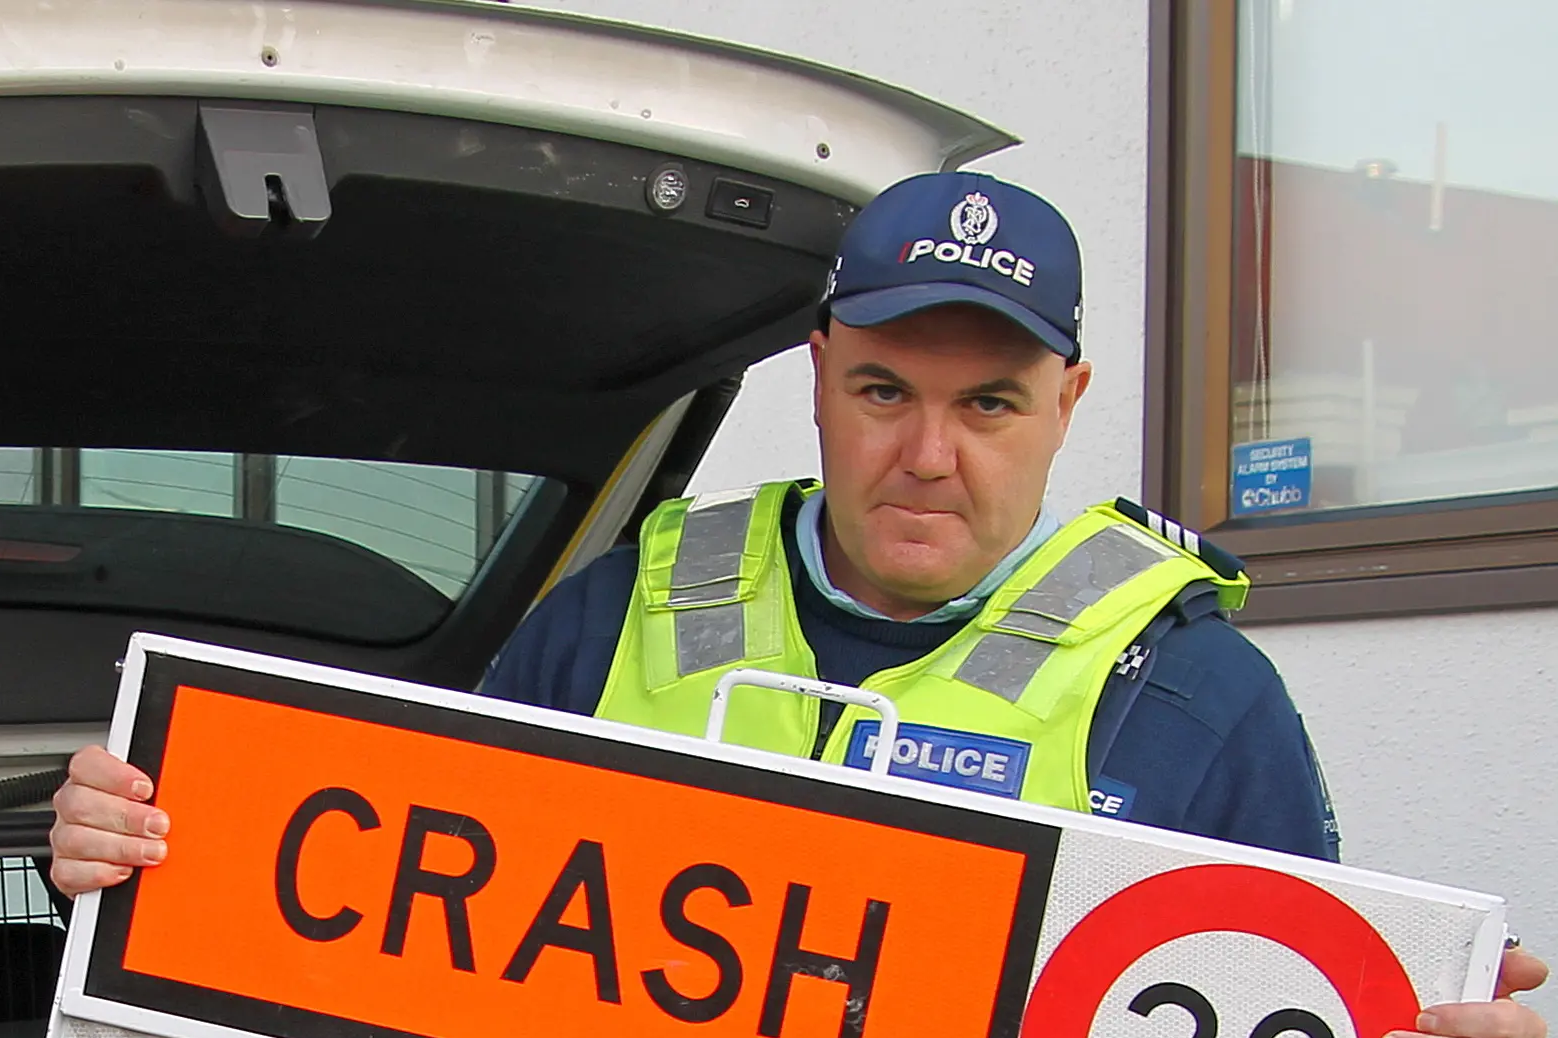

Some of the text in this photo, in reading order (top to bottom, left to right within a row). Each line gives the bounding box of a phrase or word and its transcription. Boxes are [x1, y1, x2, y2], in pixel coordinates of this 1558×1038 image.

[907, 239, 1035, 286] POLICE
[1249, 444, 1294, 461] SECURITY
[1270, 456, 1308, 471] SYSTEM
[1256, 486, 1302, 506] Chubb
[863, 735, 1009, 783] POLICE
